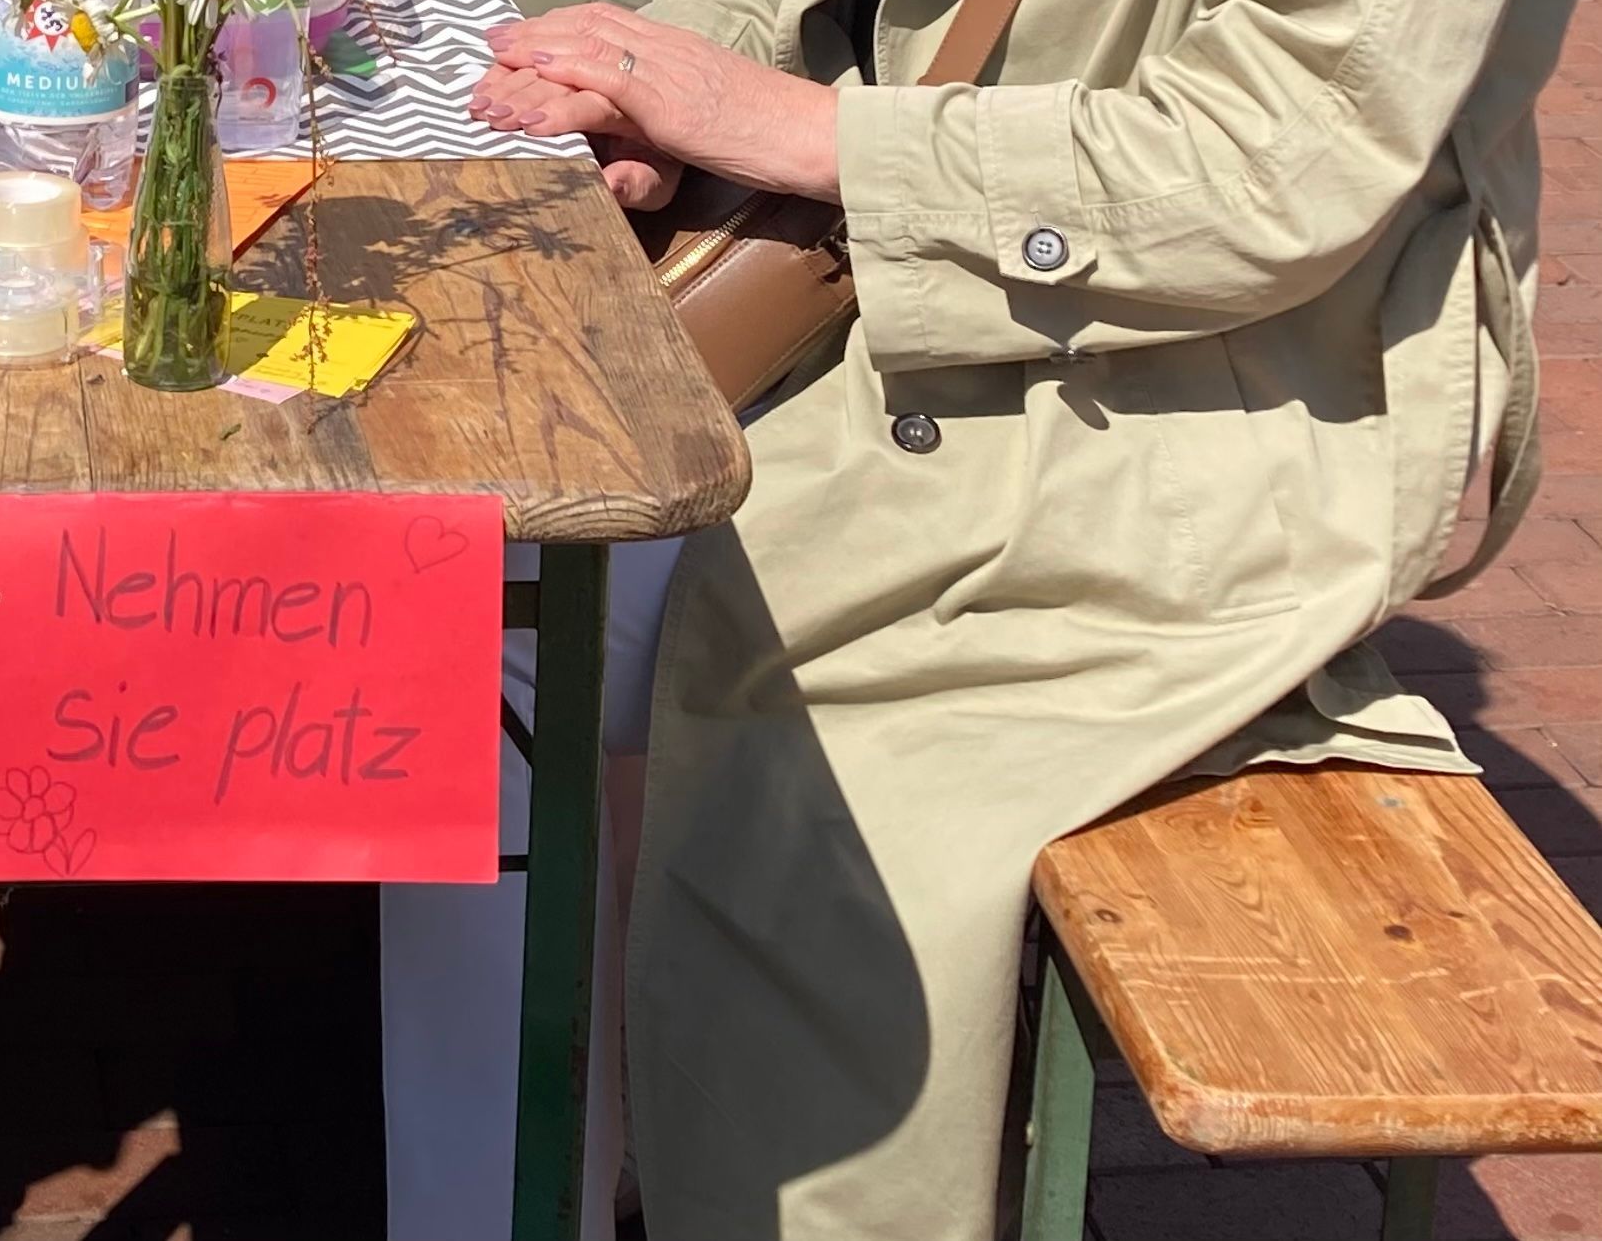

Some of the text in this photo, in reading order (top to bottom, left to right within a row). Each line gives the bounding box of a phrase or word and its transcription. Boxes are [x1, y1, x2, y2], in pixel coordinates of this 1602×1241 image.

[55, 526, 373, 648] Nehmen
[46, 680, 422, 806] Sie platz
